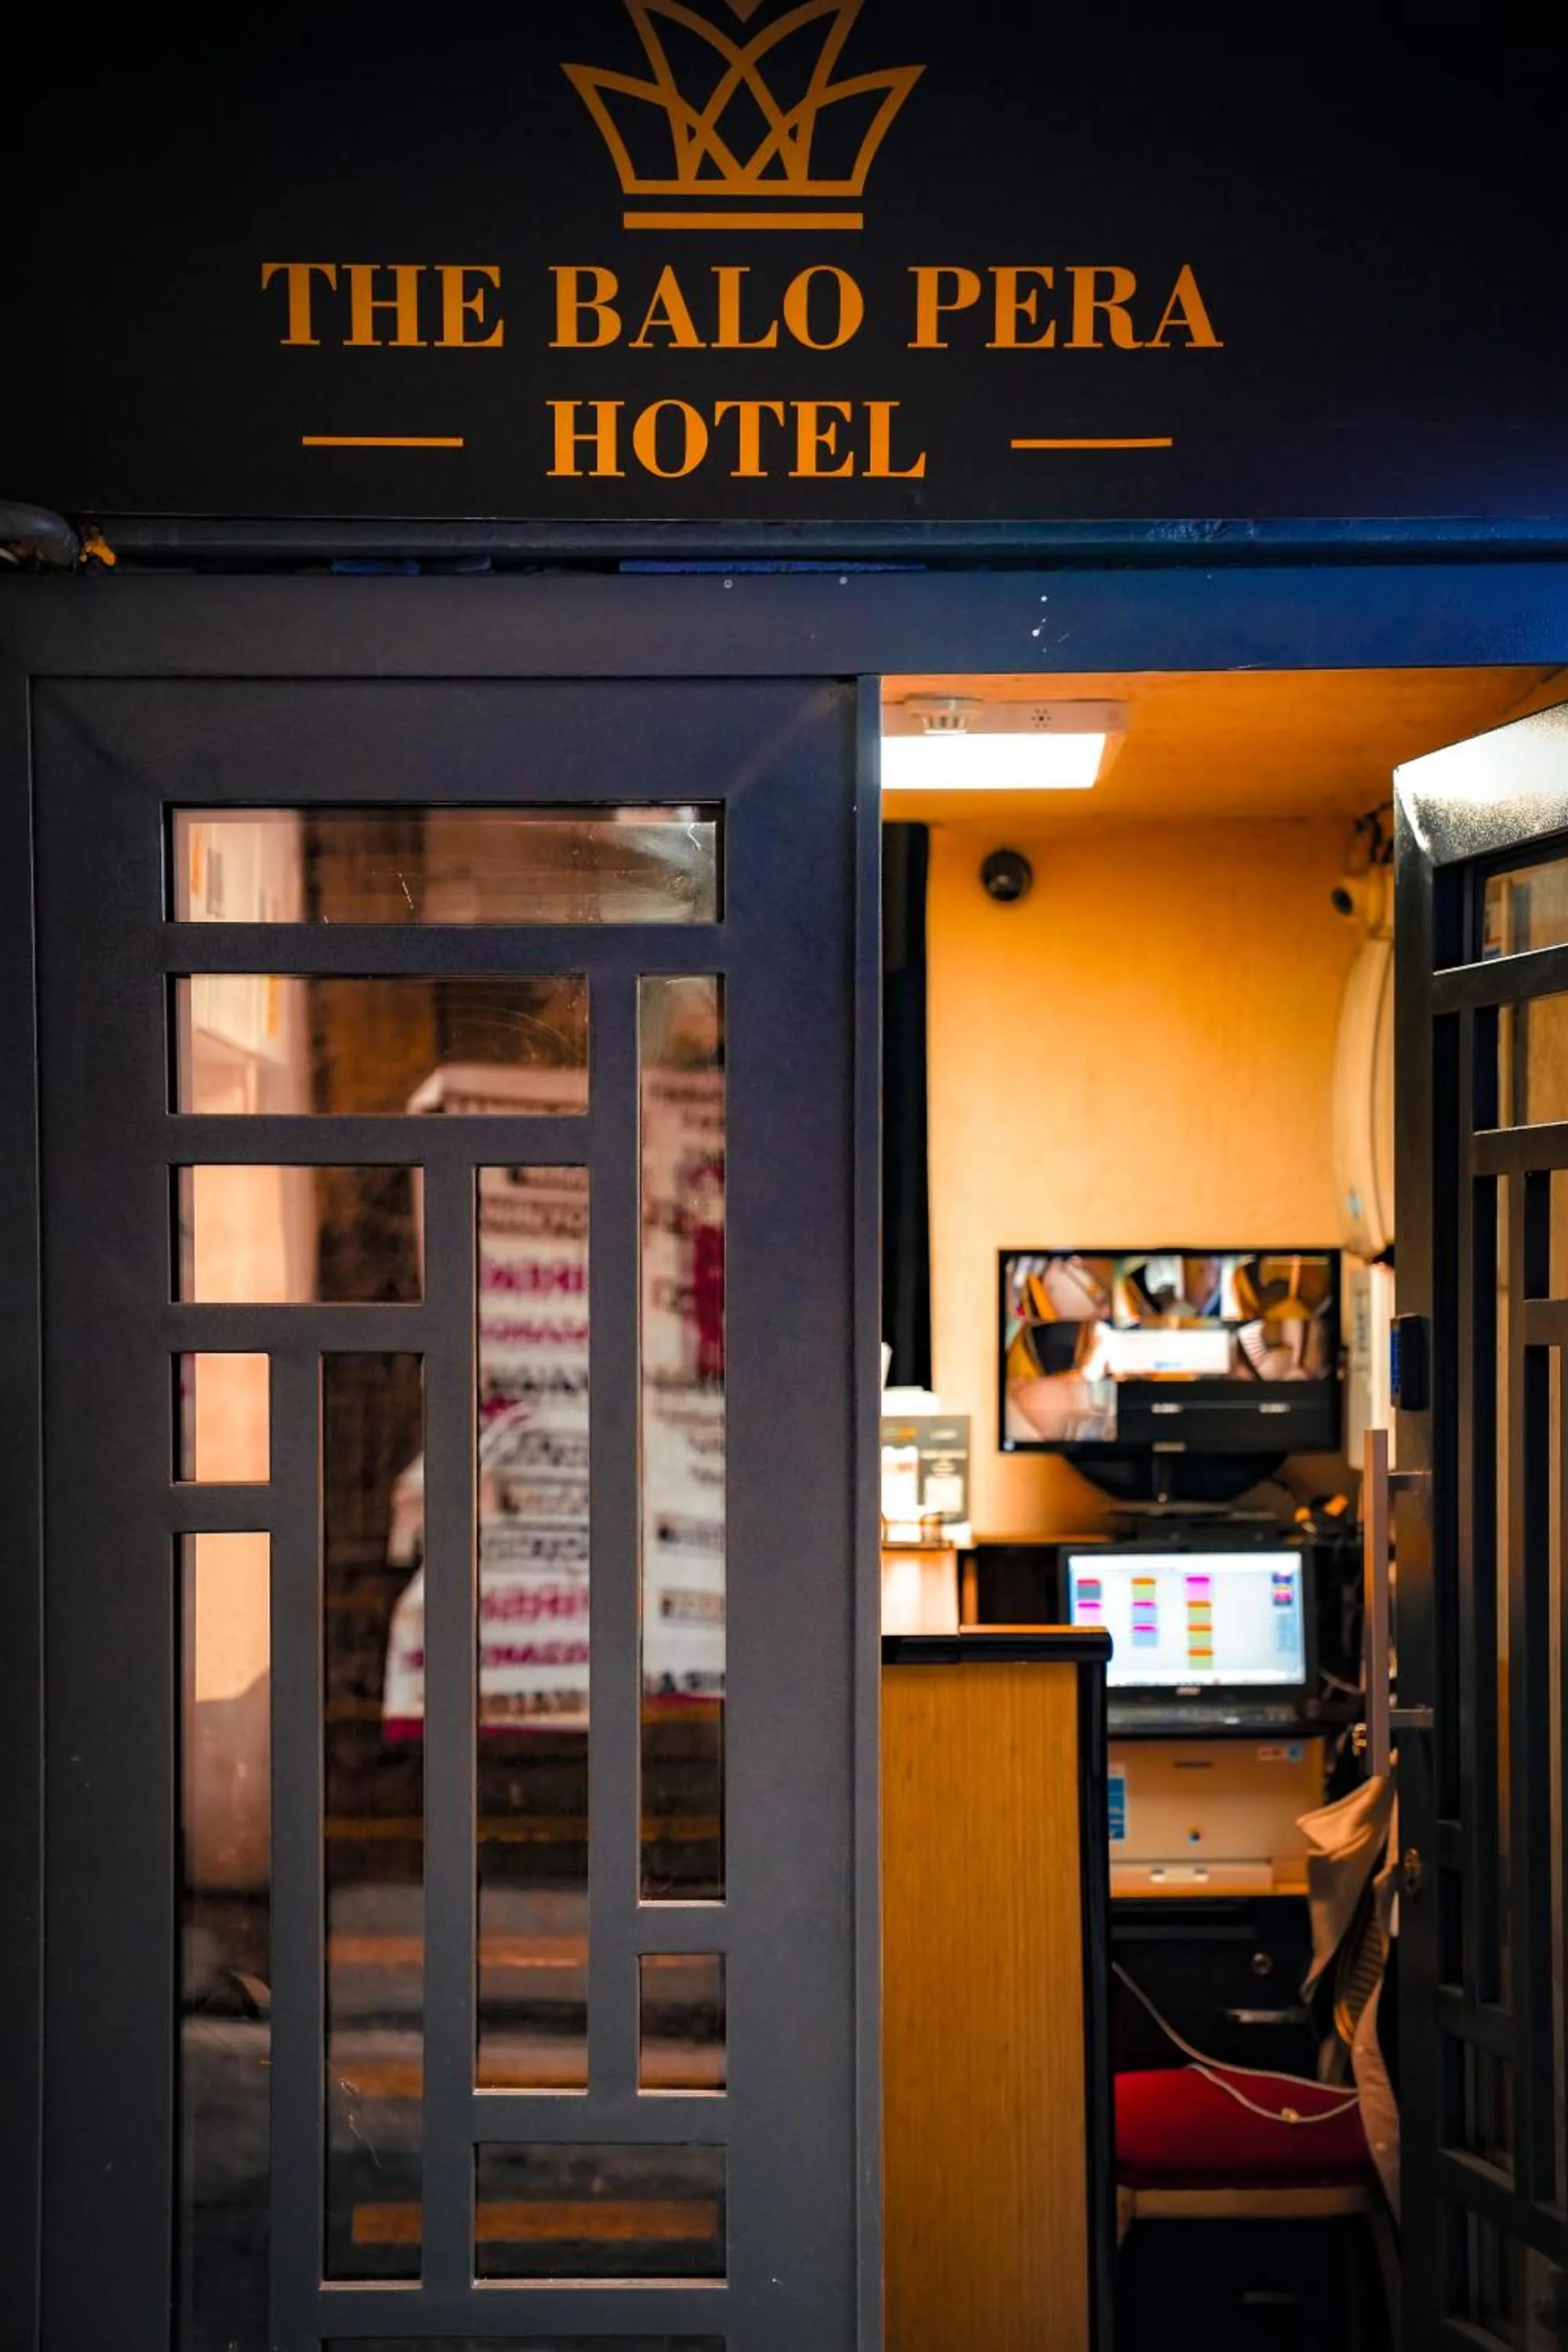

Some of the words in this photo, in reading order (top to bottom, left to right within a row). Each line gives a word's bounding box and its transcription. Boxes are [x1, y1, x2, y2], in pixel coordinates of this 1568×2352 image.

[261, 263, 504, 348] THE
[548, 264, 865, 350] BALO
[906, 264, 1225, 349] PERA
[544, 399, 927, 479] HOTEL
